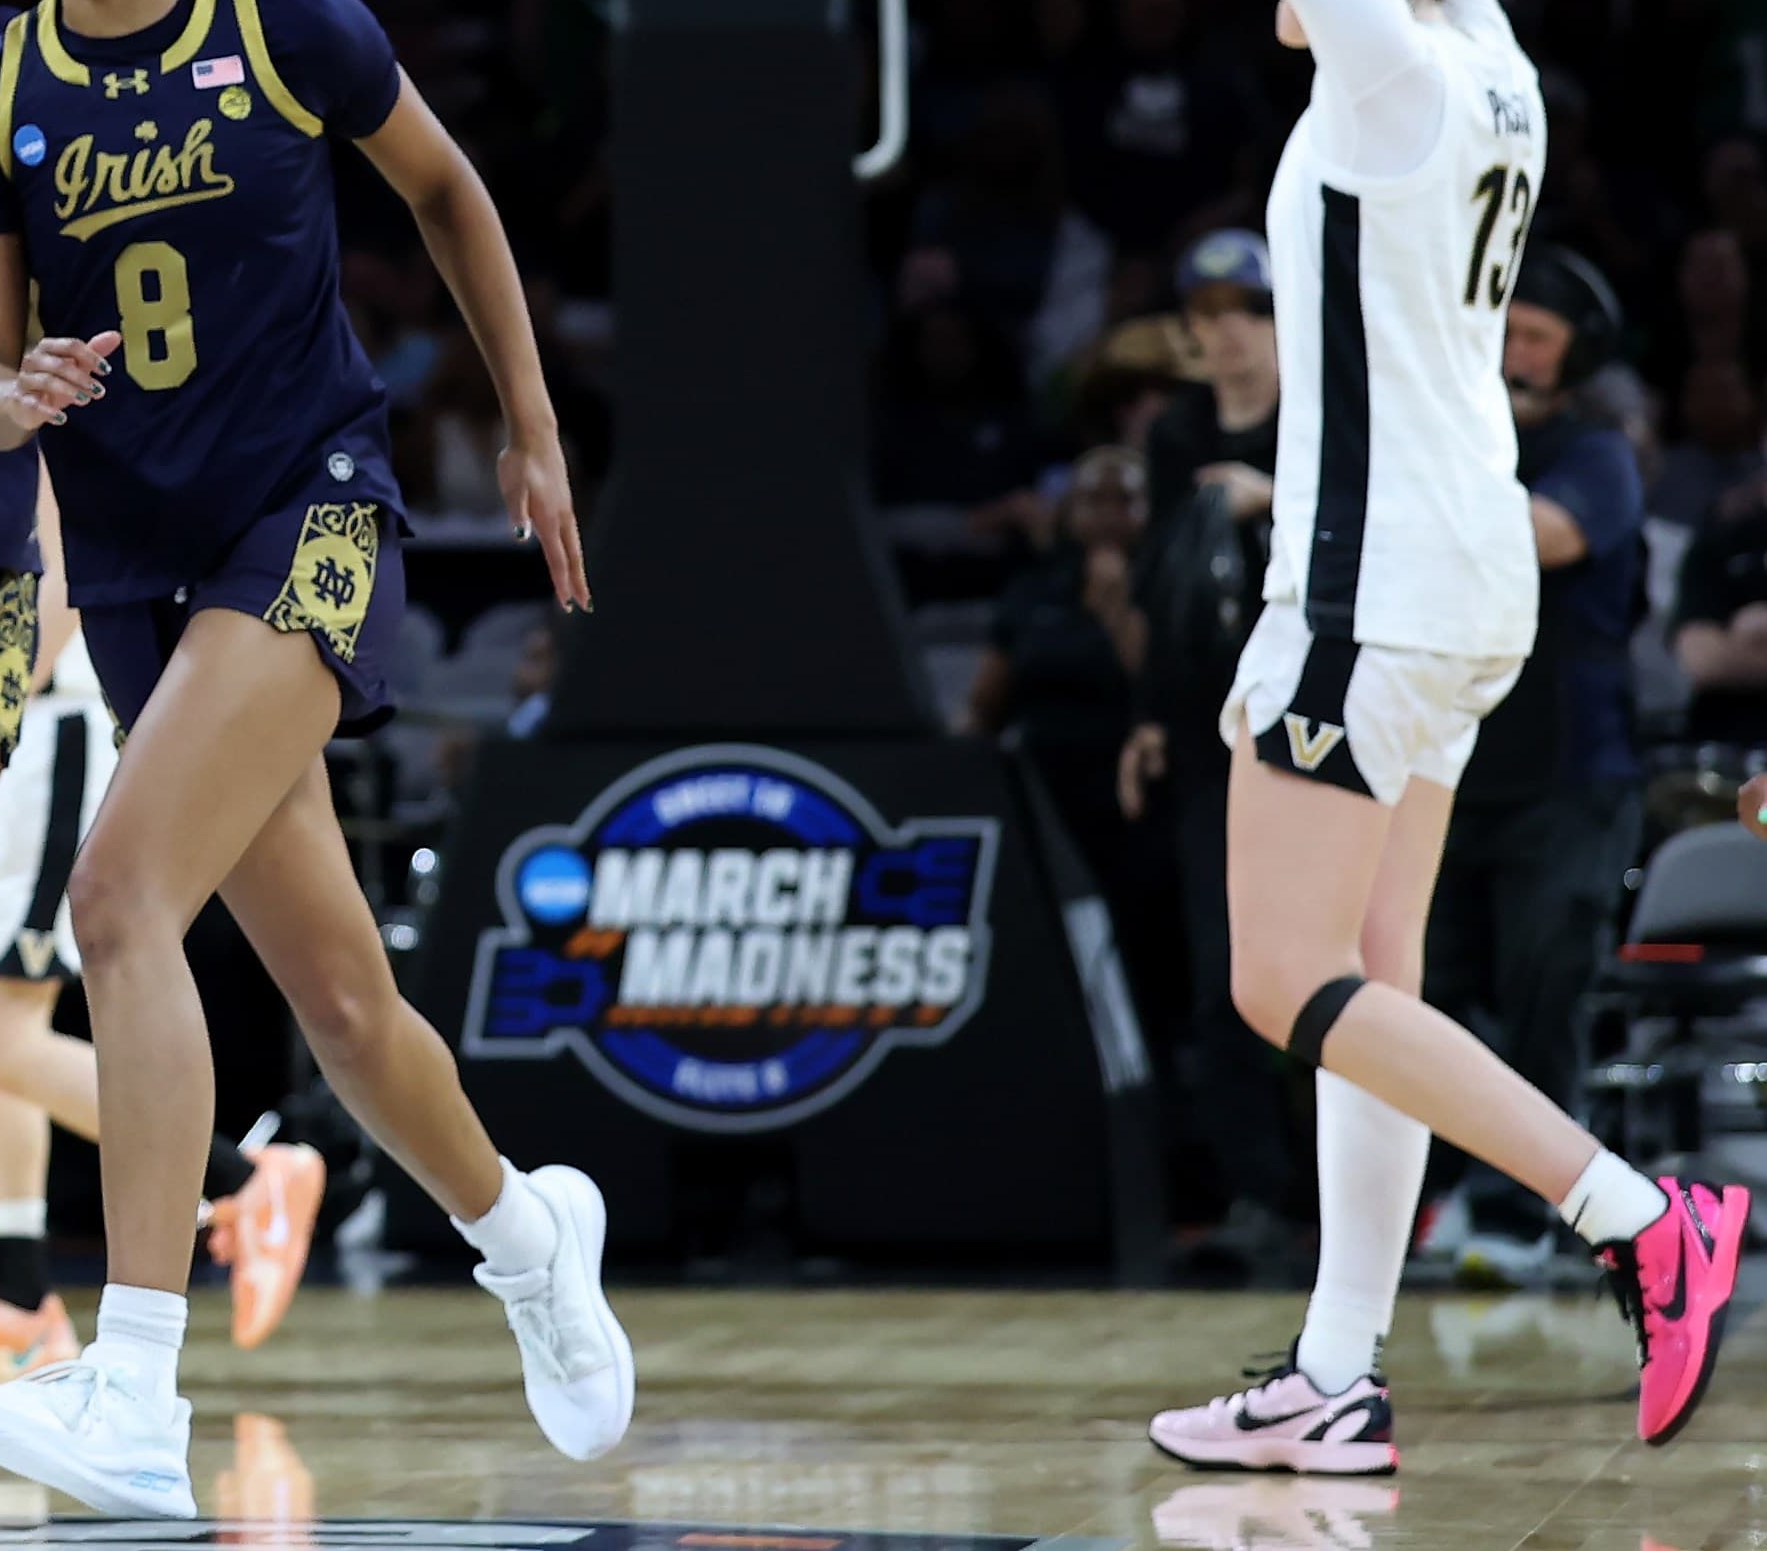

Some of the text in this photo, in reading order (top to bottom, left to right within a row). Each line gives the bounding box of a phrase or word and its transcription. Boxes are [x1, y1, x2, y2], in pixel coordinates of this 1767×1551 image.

[54, 118, 235, 220] Irish
[1463, 164, 1530, 311] 13
[114, 241, 197, 390] 8
[589, 849, 854, 925] MARCH
[619, 927, 970, 1006] MADNESS
